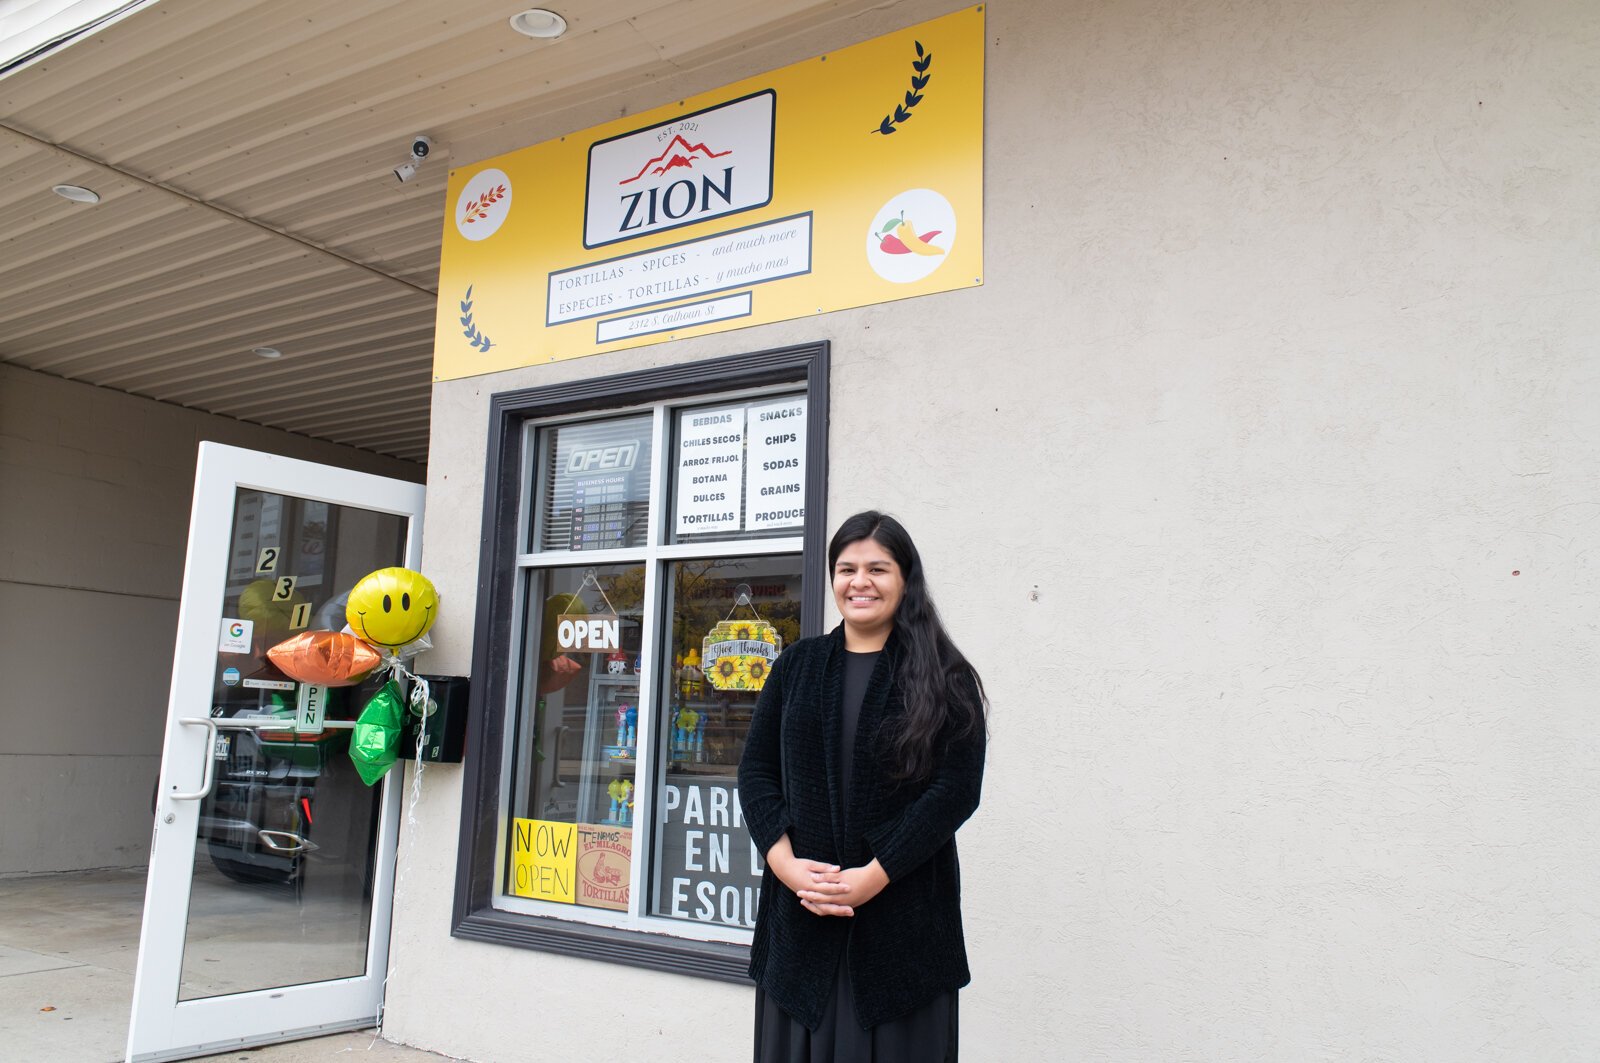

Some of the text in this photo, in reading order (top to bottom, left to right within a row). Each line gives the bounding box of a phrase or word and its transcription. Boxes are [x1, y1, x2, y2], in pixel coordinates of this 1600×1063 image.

[657, 122, 699, 142] EST. 2021
[619, 166, 735, 232] ZION
[558, 266, 624, 291] TORTILLAS
[642, 252, 686, 272] SPICES
[712, 241, 734, 256] and
[735, 234, 766, 251] much
[768, 228, 797, 243] more
[559, 293, 614, 314] ESPECIES
[628, 275, 699, 300] TORTILLAS
[716, 271, 725, 283] y
[726, 261, 763, 280] mucho
[765, 256, 789, 271] mas
[628, 318, 649, 331] 2312
[662, 309, 700, 324] Calhoun
[704, 304, 715, 315] St
[692, 414, 732, 427] BEBIDAS
[760, 407, 802, 421] SNACKS
[683, 434, 741, 447] CHILES SECOS
[765, 433, 796, 445] CHIPS
[569, 446, 634, 472] OPEN
[683, 454, 739, 467] ARROZ FRIJOL
[763, 458, 798, 470] SODAS
[577, 476, 625, 487] BUSINESS HOURS
[692, 474, 728, 484] BOTANA
[693, 492, 725, 502] DULCES
[760, 483, 800, 496] GRAINS
[682, 512, 735, 524] TORTILLAS
[755, 508, 804, 522] PRODUCE
[557, 620, 619, 649] OPEN
[713, 644, 733, 657] Give
[304, 687, 318, 724] PEN
[516, 822, 572, 858] NOW
[584, 841, 631, 857] EL MILAGRO
[685, 830, 731, 873] EN
[516, 863, 569, 895] OPEN
[583, 880, 630, 904] TORTILLAS
